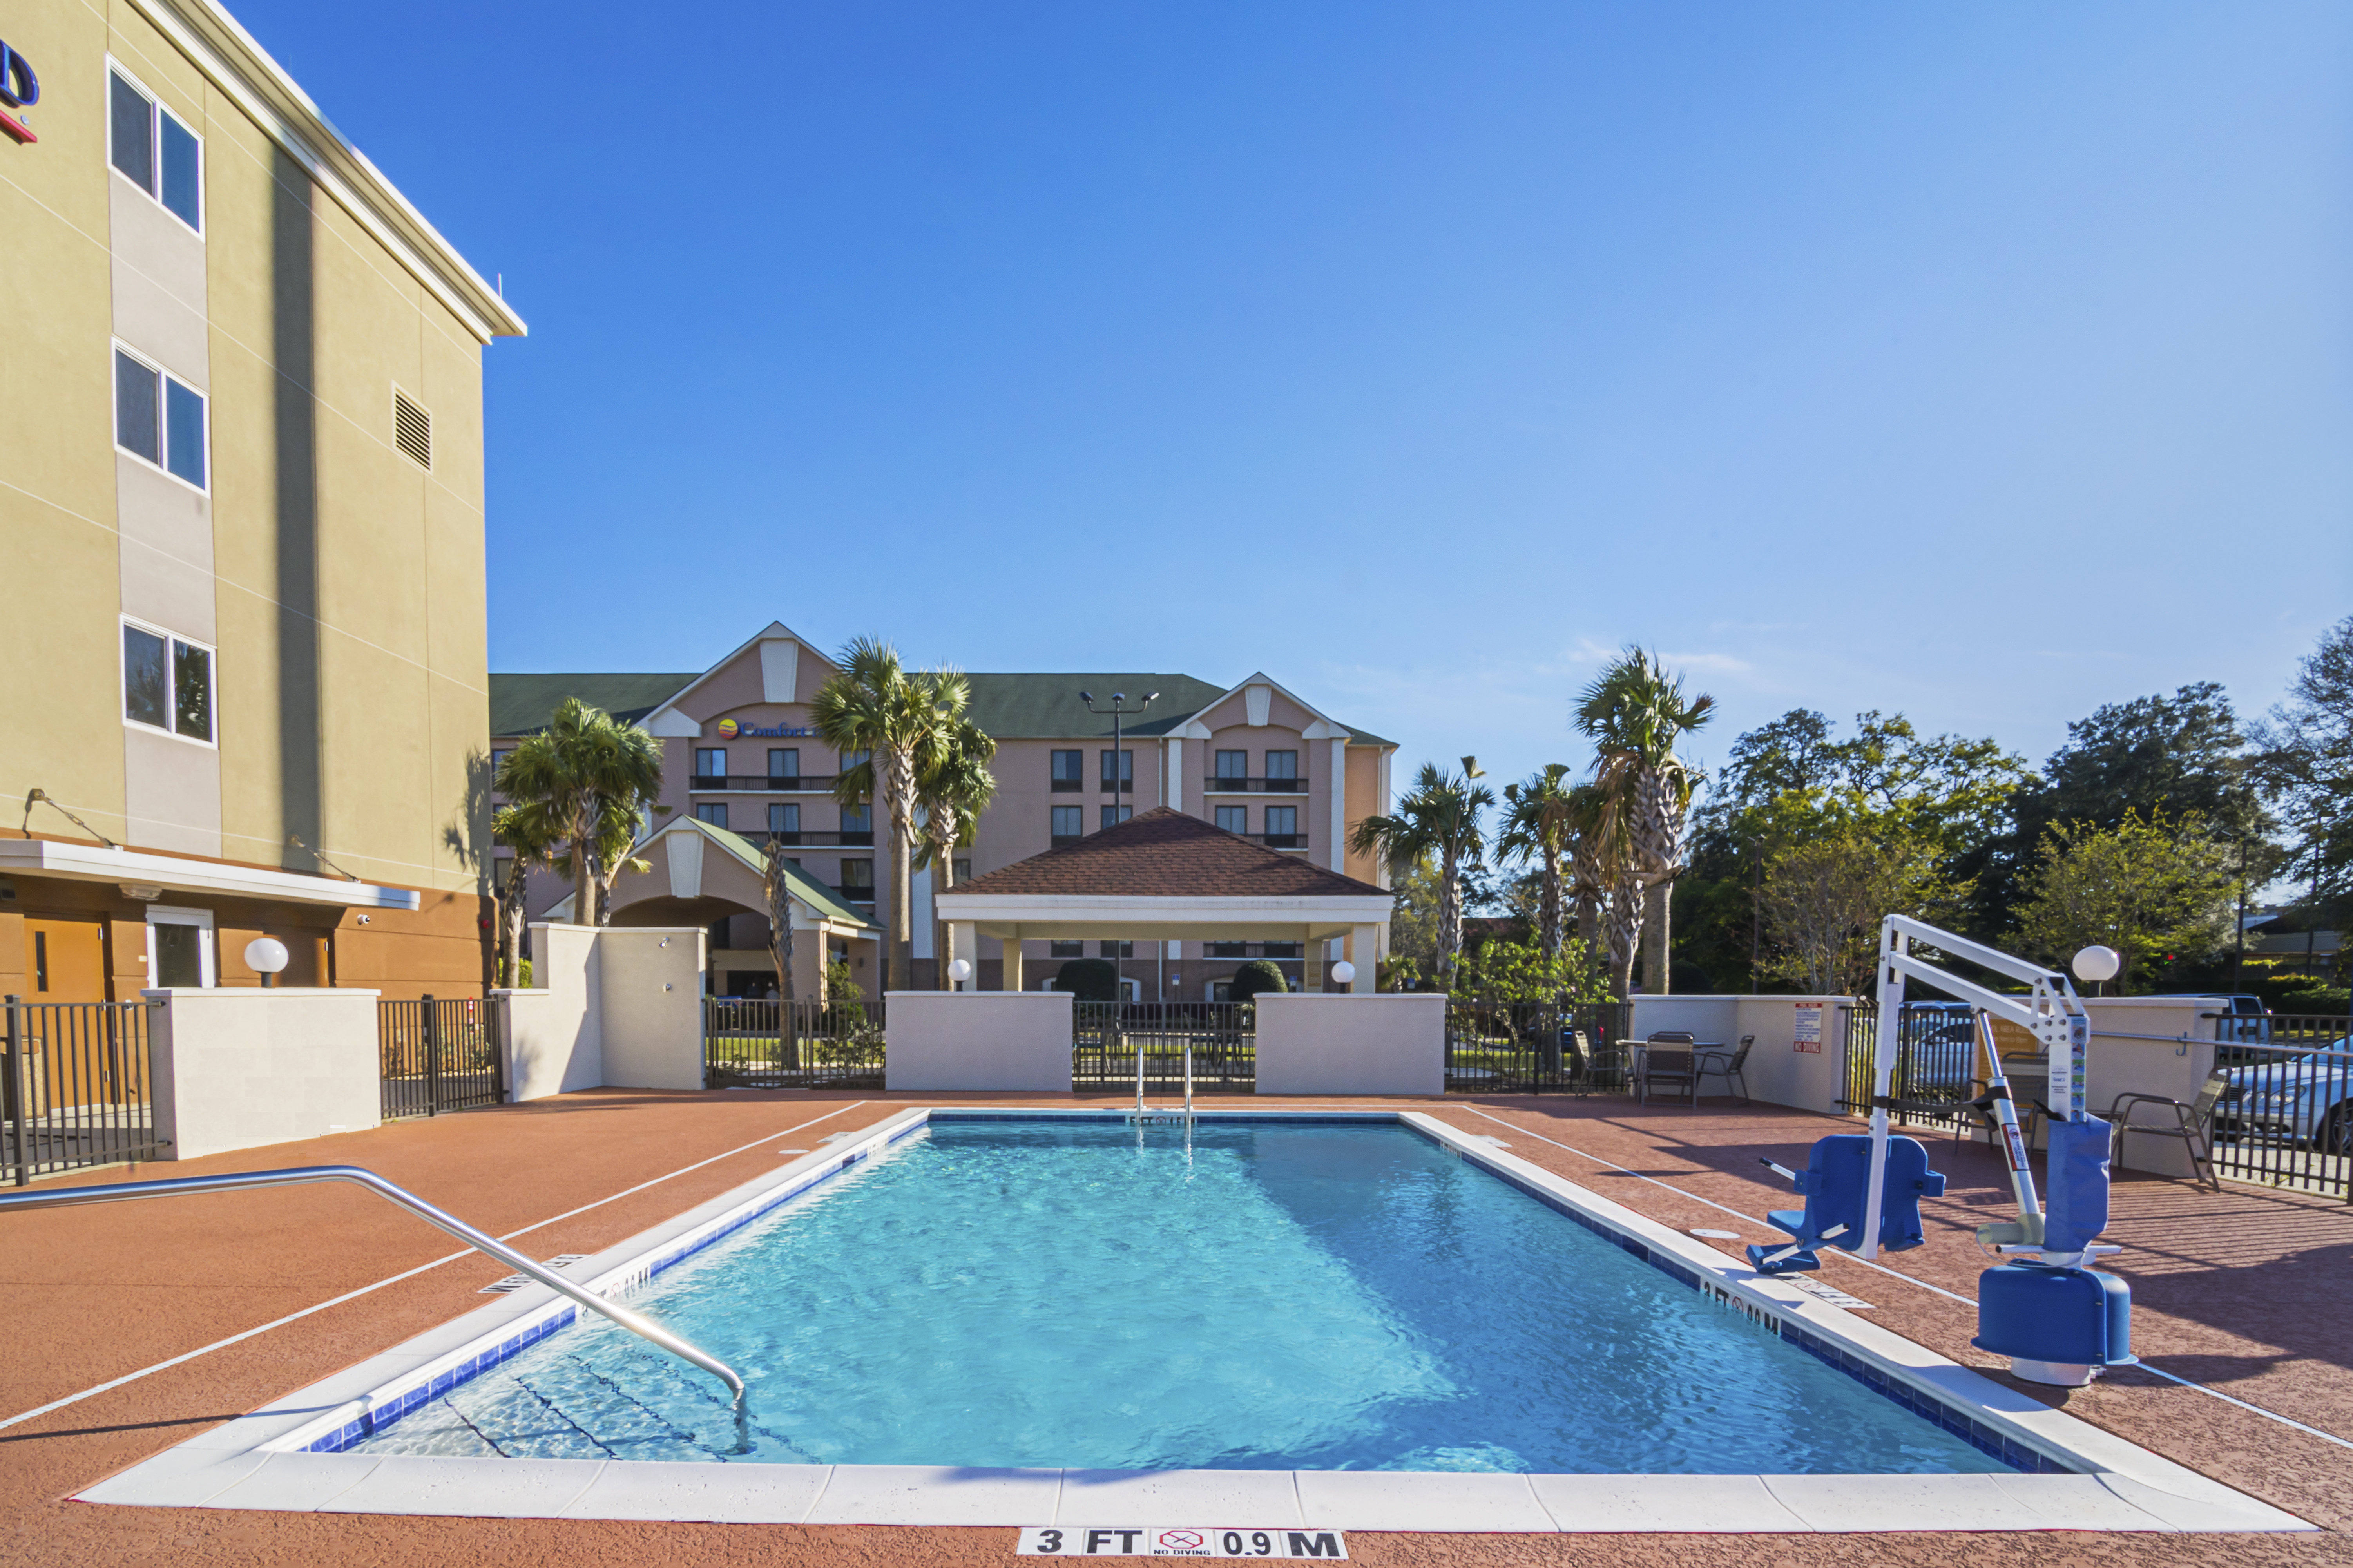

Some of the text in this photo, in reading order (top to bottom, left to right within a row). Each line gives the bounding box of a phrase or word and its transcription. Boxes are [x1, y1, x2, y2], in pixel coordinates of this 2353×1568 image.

[741, 722, 807, 737] Comfort
[1037, 1530, 1142, 1554] 3 FT
[1223, 1532, 1340, 1557] 0.9 M
